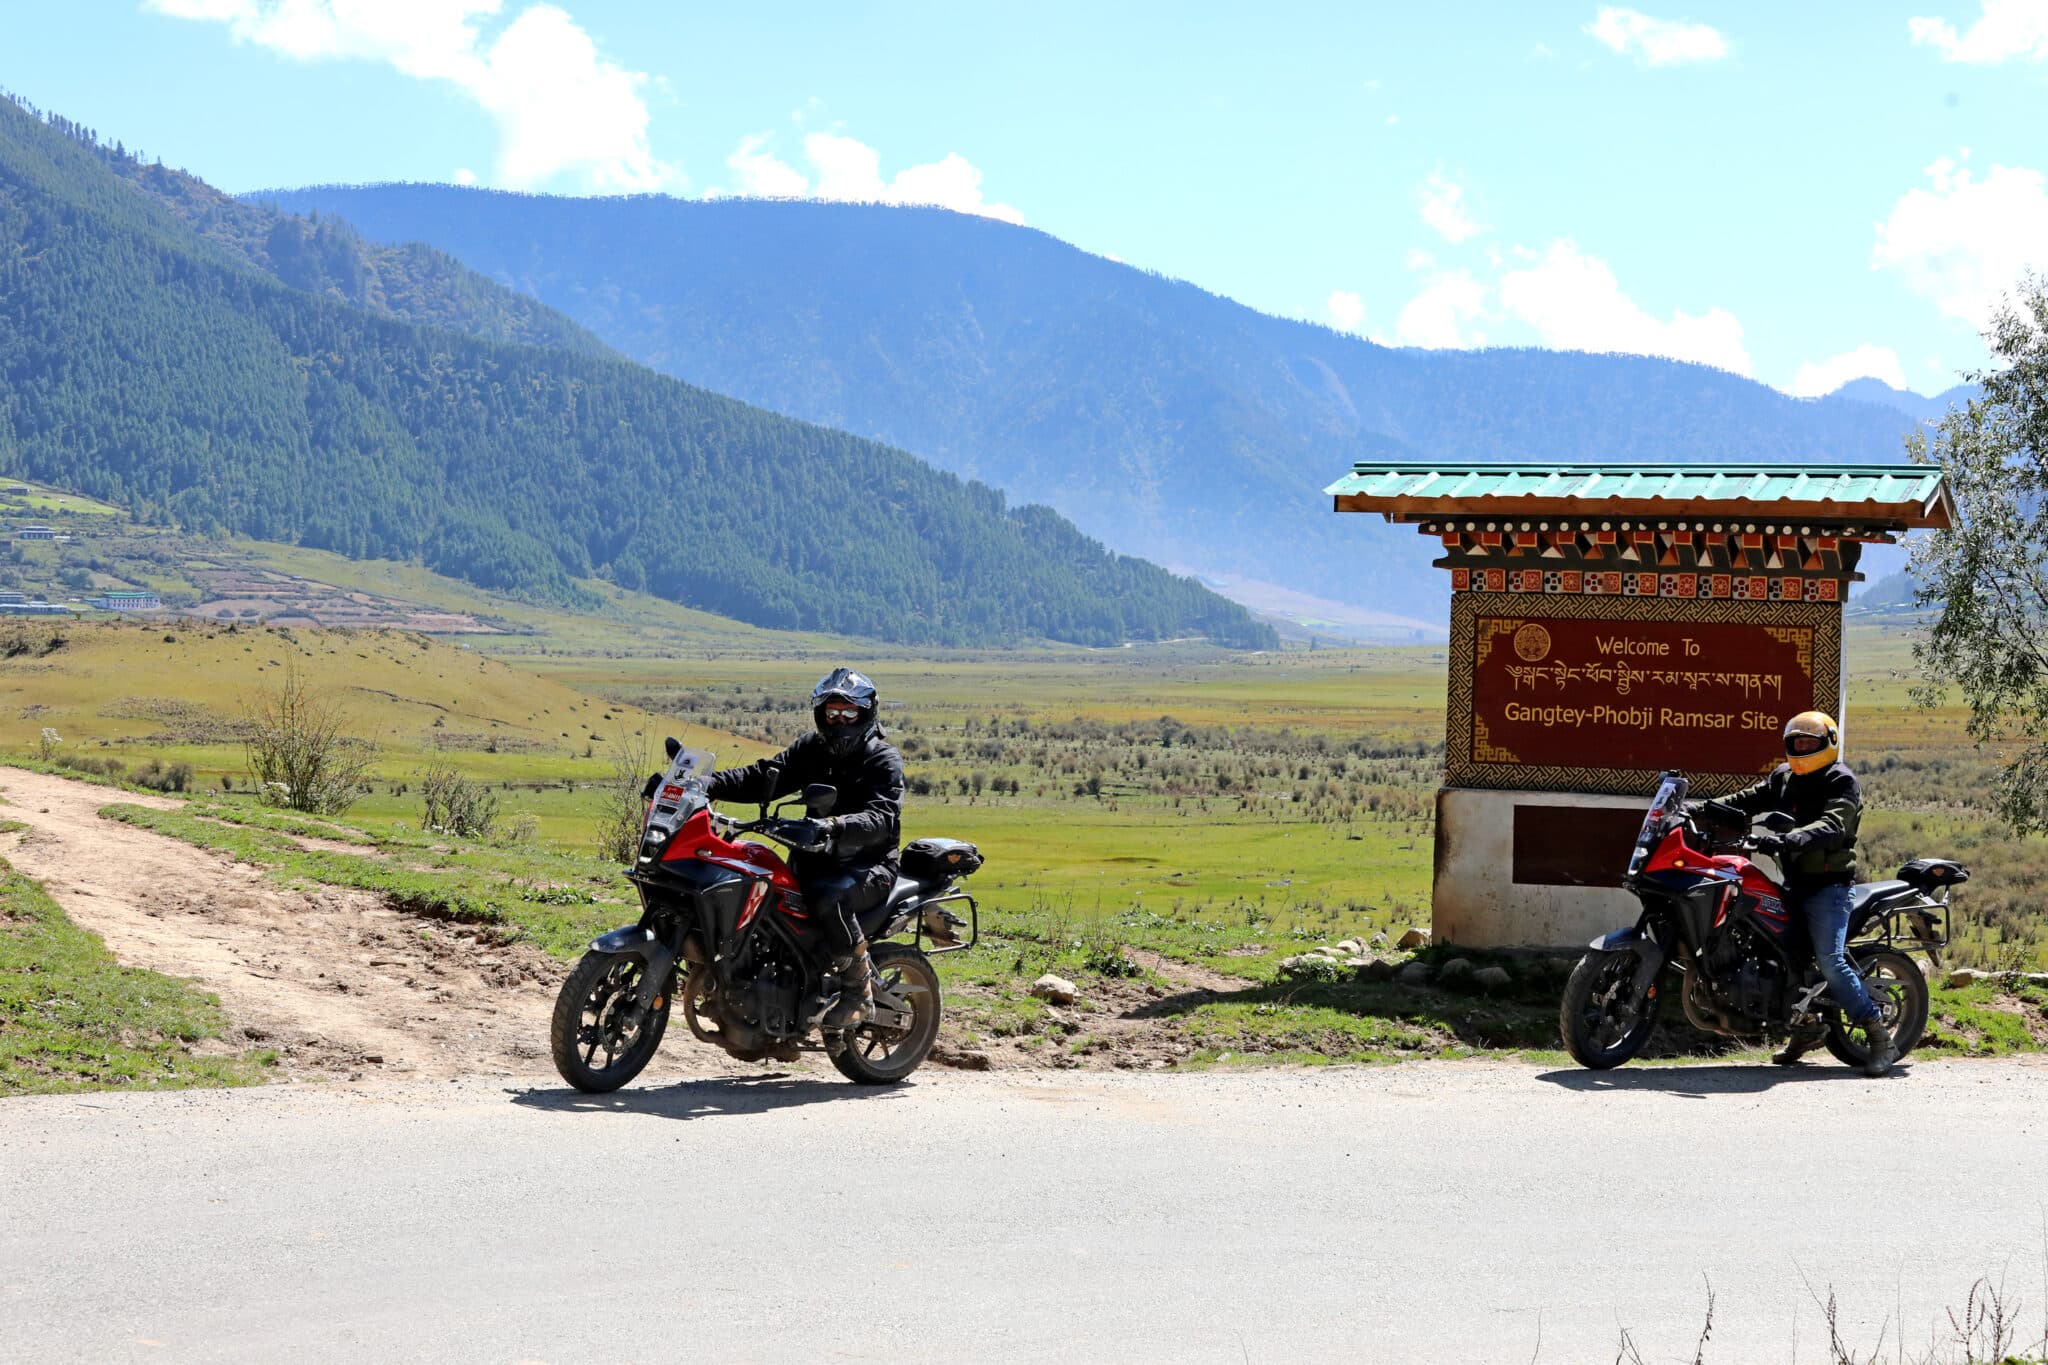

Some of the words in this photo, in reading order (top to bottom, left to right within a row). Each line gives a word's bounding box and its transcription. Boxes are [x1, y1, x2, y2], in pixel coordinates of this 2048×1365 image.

[1595, 635, 1670, 656] Welcome
[1682, 638, 1701, 656] To
[1504, 702, 1653, 729] Gangtey-Phobji
[1660, 708, 1735, 729] Ramsar
[1740, 710, 1779, 731] Site
